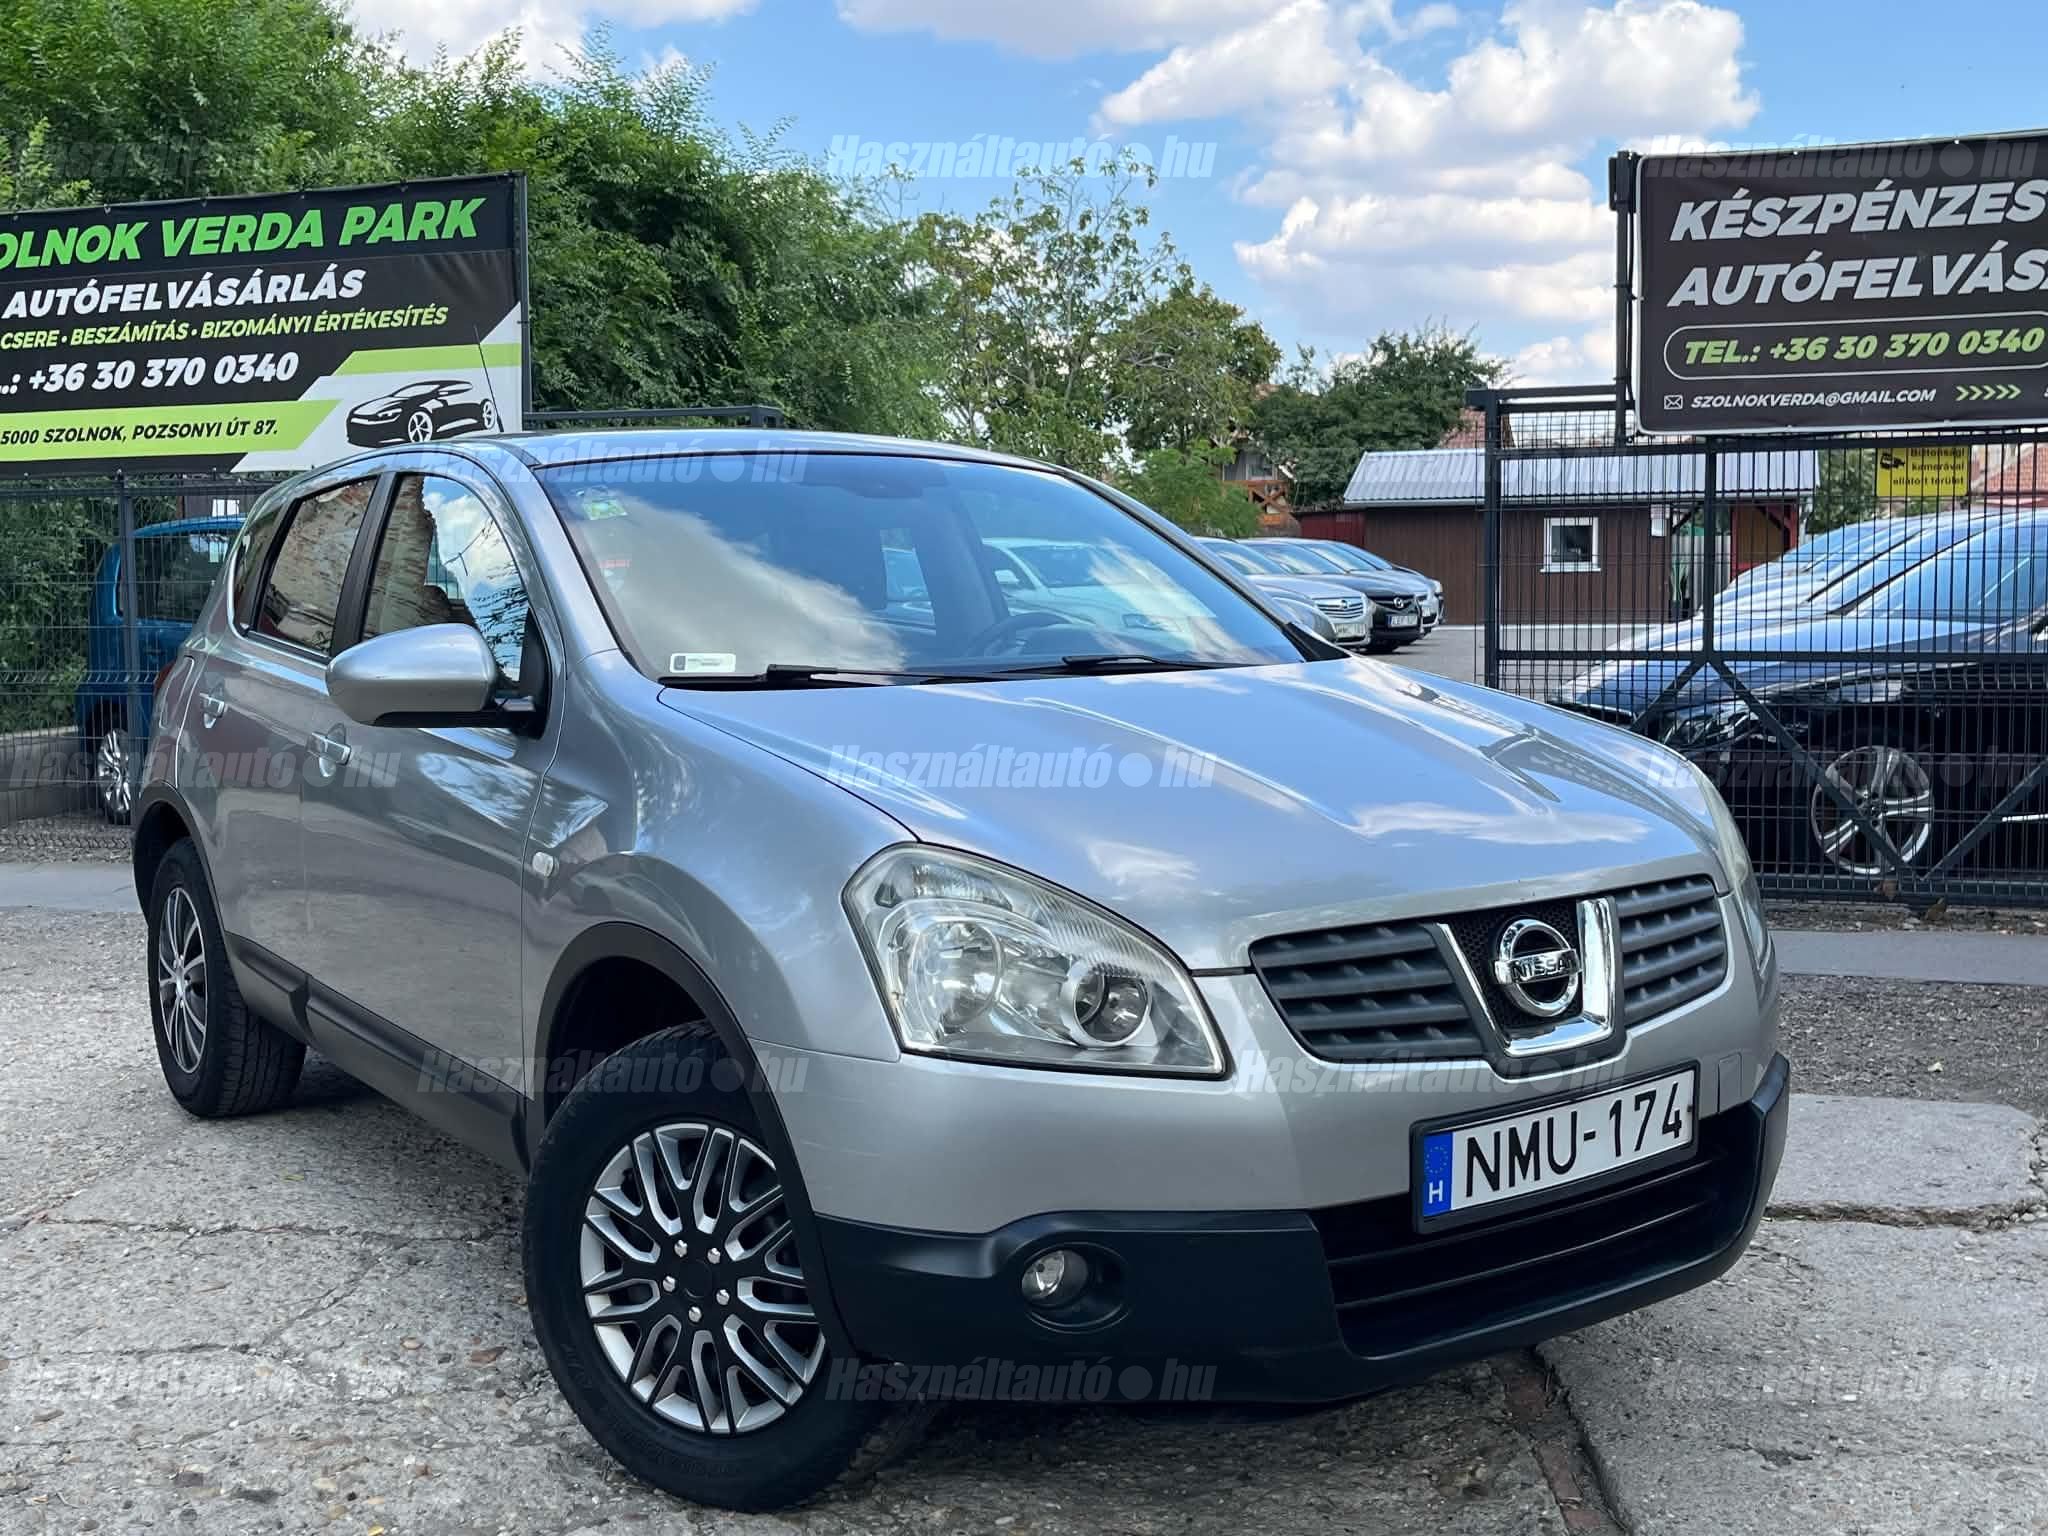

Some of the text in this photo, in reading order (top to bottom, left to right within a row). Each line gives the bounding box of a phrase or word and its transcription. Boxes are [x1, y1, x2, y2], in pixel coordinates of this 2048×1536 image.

[161, 208, 325, 257] VERDA
[338, 196, 488, 247] PARK
[1670, 179, 2048, 241] KÉSZPÉNZES
[1, 263, 368, 319] AUTÓFELVÁSÁRLÁS
[1667, 239, 2048, 307] AUTÓFELVÁS
[1, 305, 449, 350] CSERE BESZÁMÍTÁS BIZOMÁNYI ÉRTÉKESÍTÉS
[1684, 327, 2045, 365] TEL.: +36 30 370 0340
[29, 361, 88, 393] +36
[91, 359, 136, 391] 30
[141, 356, 206, 389] 370
[214, 351, 301, 385] 0340
[1690, 388, 1937, 410] SZOLNOKVERDA@GMAIL.COM
[1, 417, 279, 445] 5000 SZOLNOK, POZSONYI ÚT 87.
[1465, 1080, 1683, 1198] NMU-174
[1428, 1180, 1444, 1204] H
